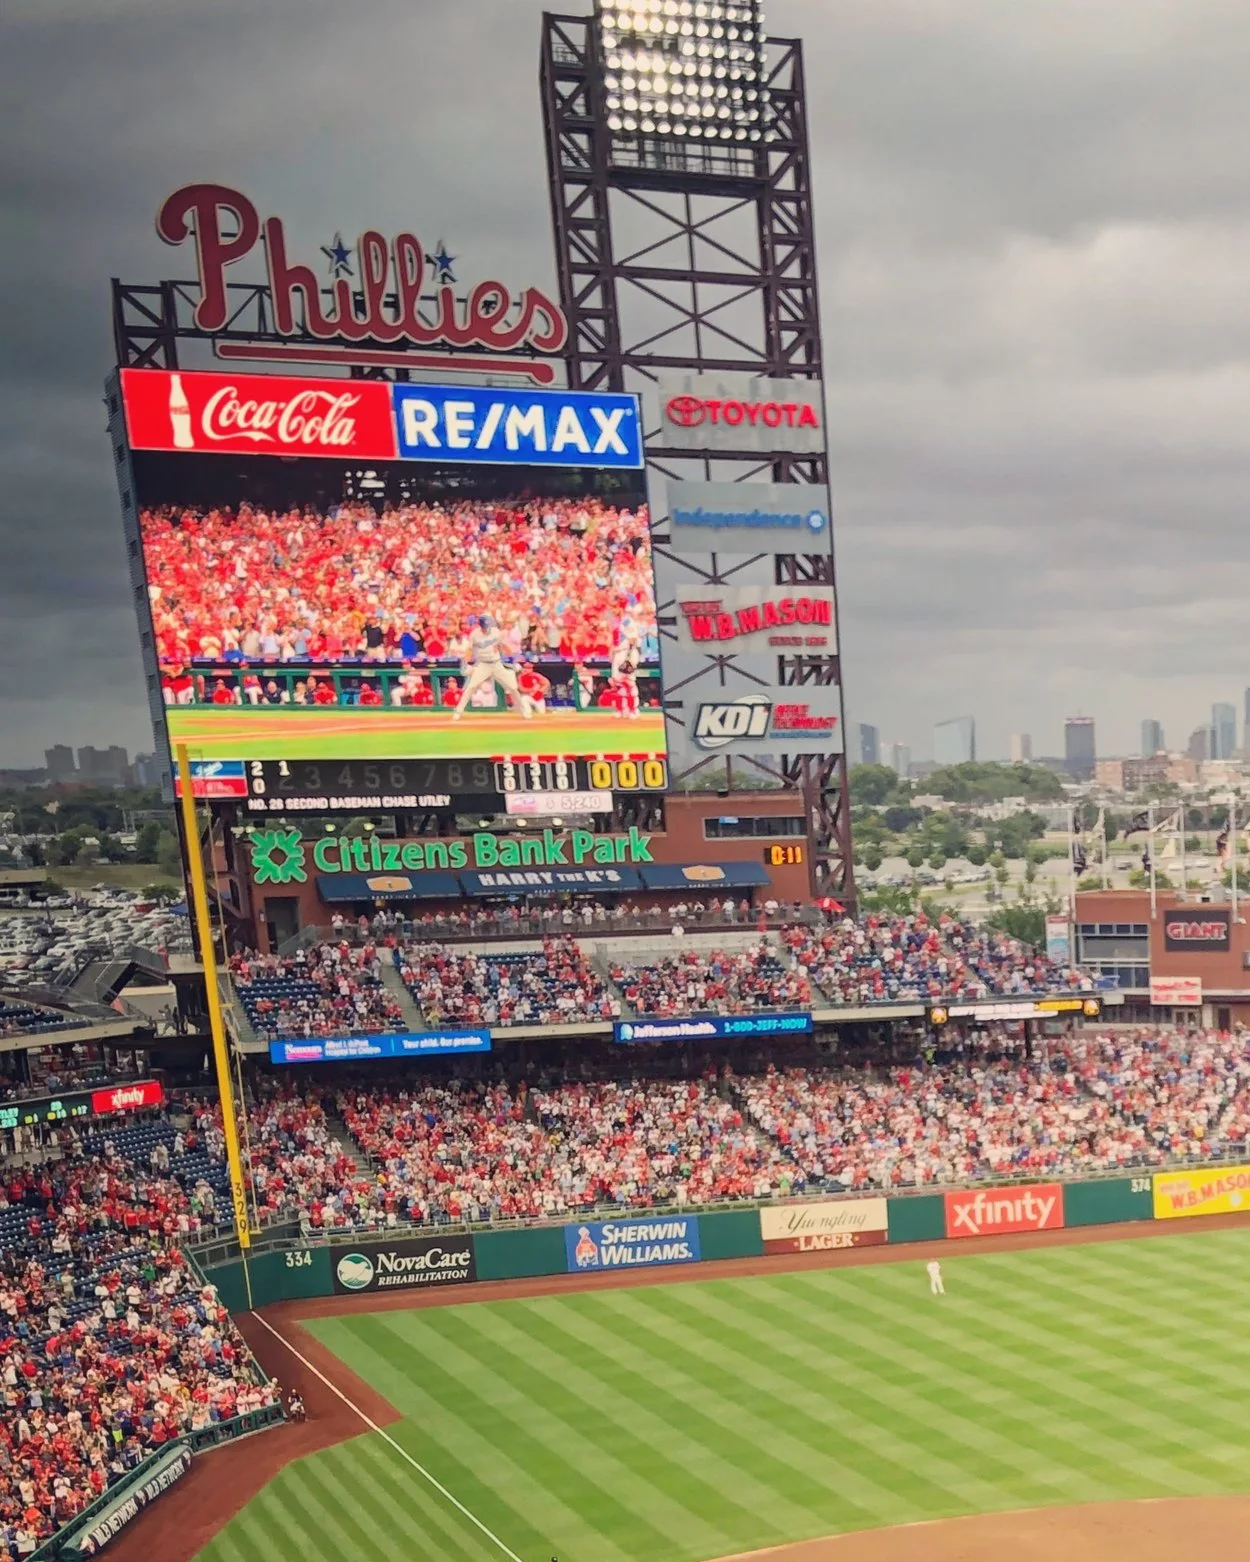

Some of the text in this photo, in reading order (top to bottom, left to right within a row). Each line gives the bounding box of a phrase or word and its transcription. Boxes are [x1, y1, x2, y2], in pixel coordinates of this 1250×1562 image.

[156, 183, 569, 352] Phillies
[202, 386, 361, 445] Coca-Cola
[705, 399, 819, 428] TOYOTA
[401, 399, 630, 456] RE/MAX
[697, 704, 771, 737] KDI
[251, 760, 264, 776] 2
[278, 760, 290, 776] 1
[591, 761, 612, 789] 0
[618, 761, 637, 788] 0
[643, 760, 664, 788] 0
[252, 777, 266, 795] 0
[248, 799, 267, 810] NO.
[285, 797, 328, 810] SECOND
[330, 796, 380, 809] BASEMAN
[381, 795, 418, 808] CHASE
[419, 794, 451, 807] UTLEY
[314, 826, 654, 873] Citizens Bank Park
[478, 871, 554, 887] HARRY
[585, 869, 621, 884] K'S
[1166, 921, 1227, 941] GIANT
[724, 1017, 807, 1033] 1-800-JEFF-NOW
[1131, 1178, 1151, 1193] 374
[779, 1207, 868, 1233] Yuengling
[953, 1191, 1056, 1234] xfinity
[601, 1221, 687, 1245] SHERWIN
[800, 1232, 854, 1251] LAGER
[285, 1250, 313, 1268] 334
[375, 1248, 470, 1275] NovaCare
[378, 1268, 469, 1287] REHABILITATION
[110, 1497, 139, 1535] NETWORK
[158, 1457, 186, 1492] NETWORK
